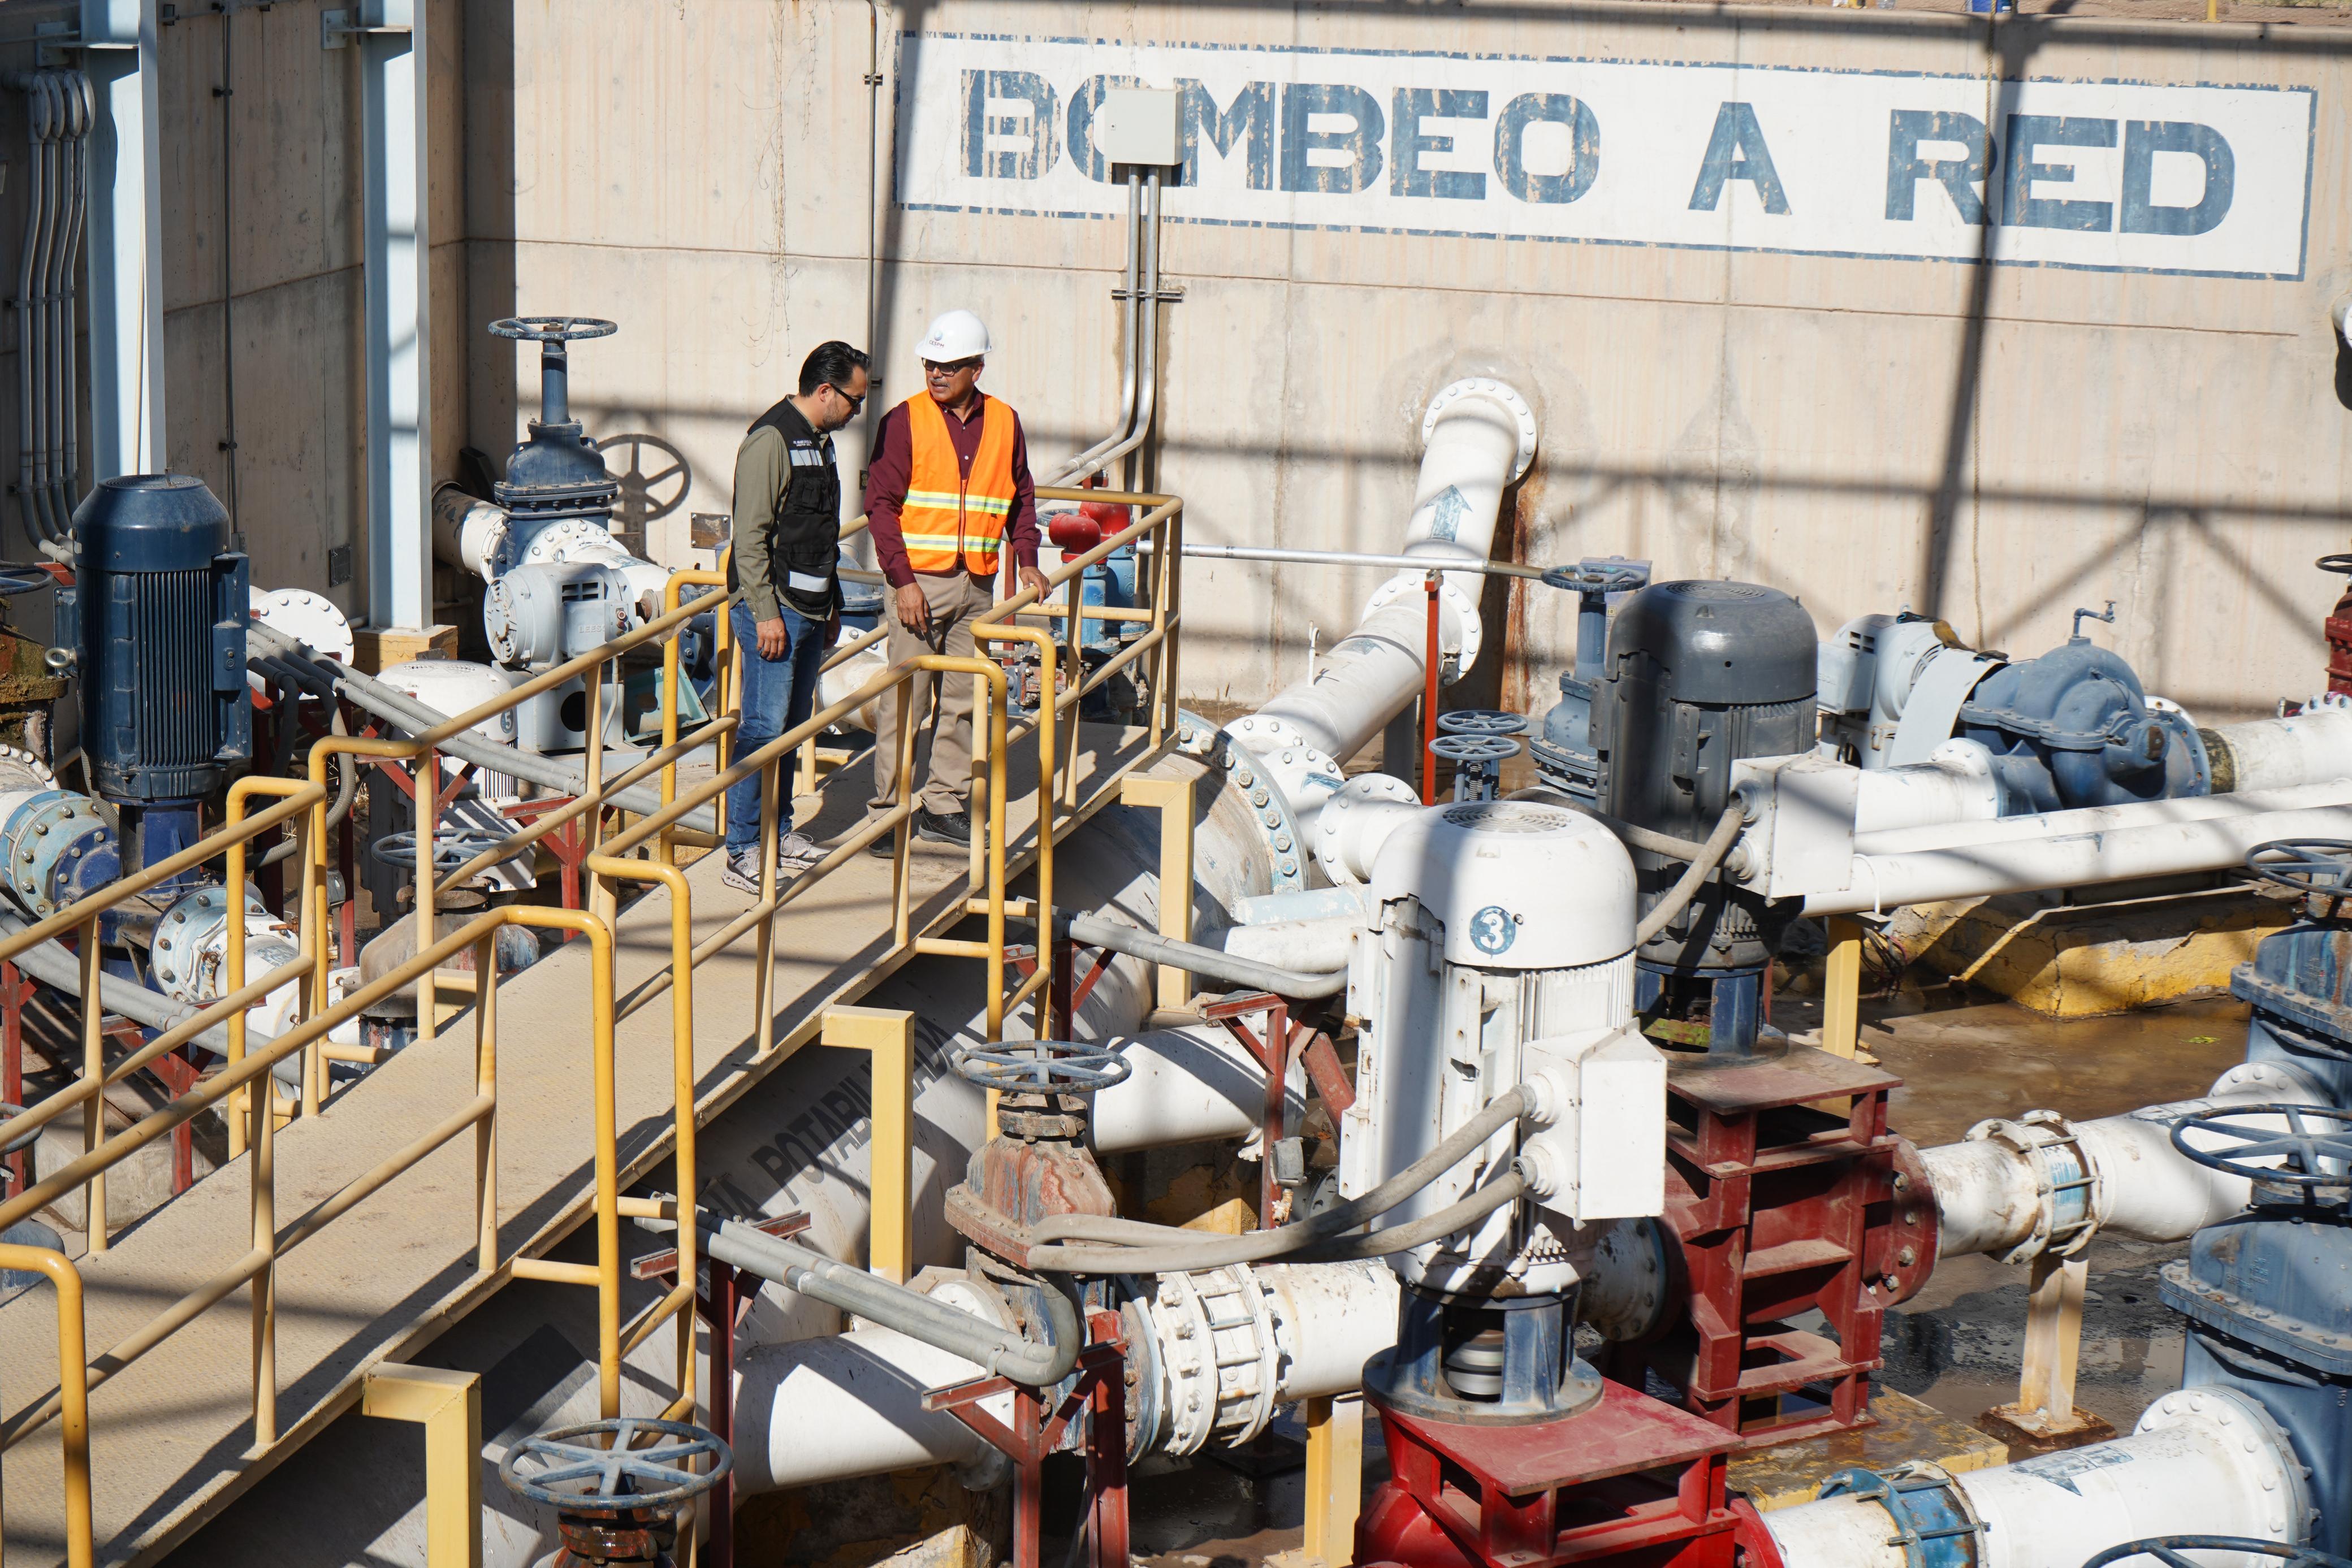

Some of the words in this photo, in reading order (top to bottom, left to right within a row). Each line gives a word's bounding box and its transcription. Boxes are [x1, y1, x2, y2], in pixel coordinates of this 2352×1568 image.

[1687, 101, 1791, 216] A
[1884, 109, 2236, 236] RED
[1479, 912, 1504, 950] 3
